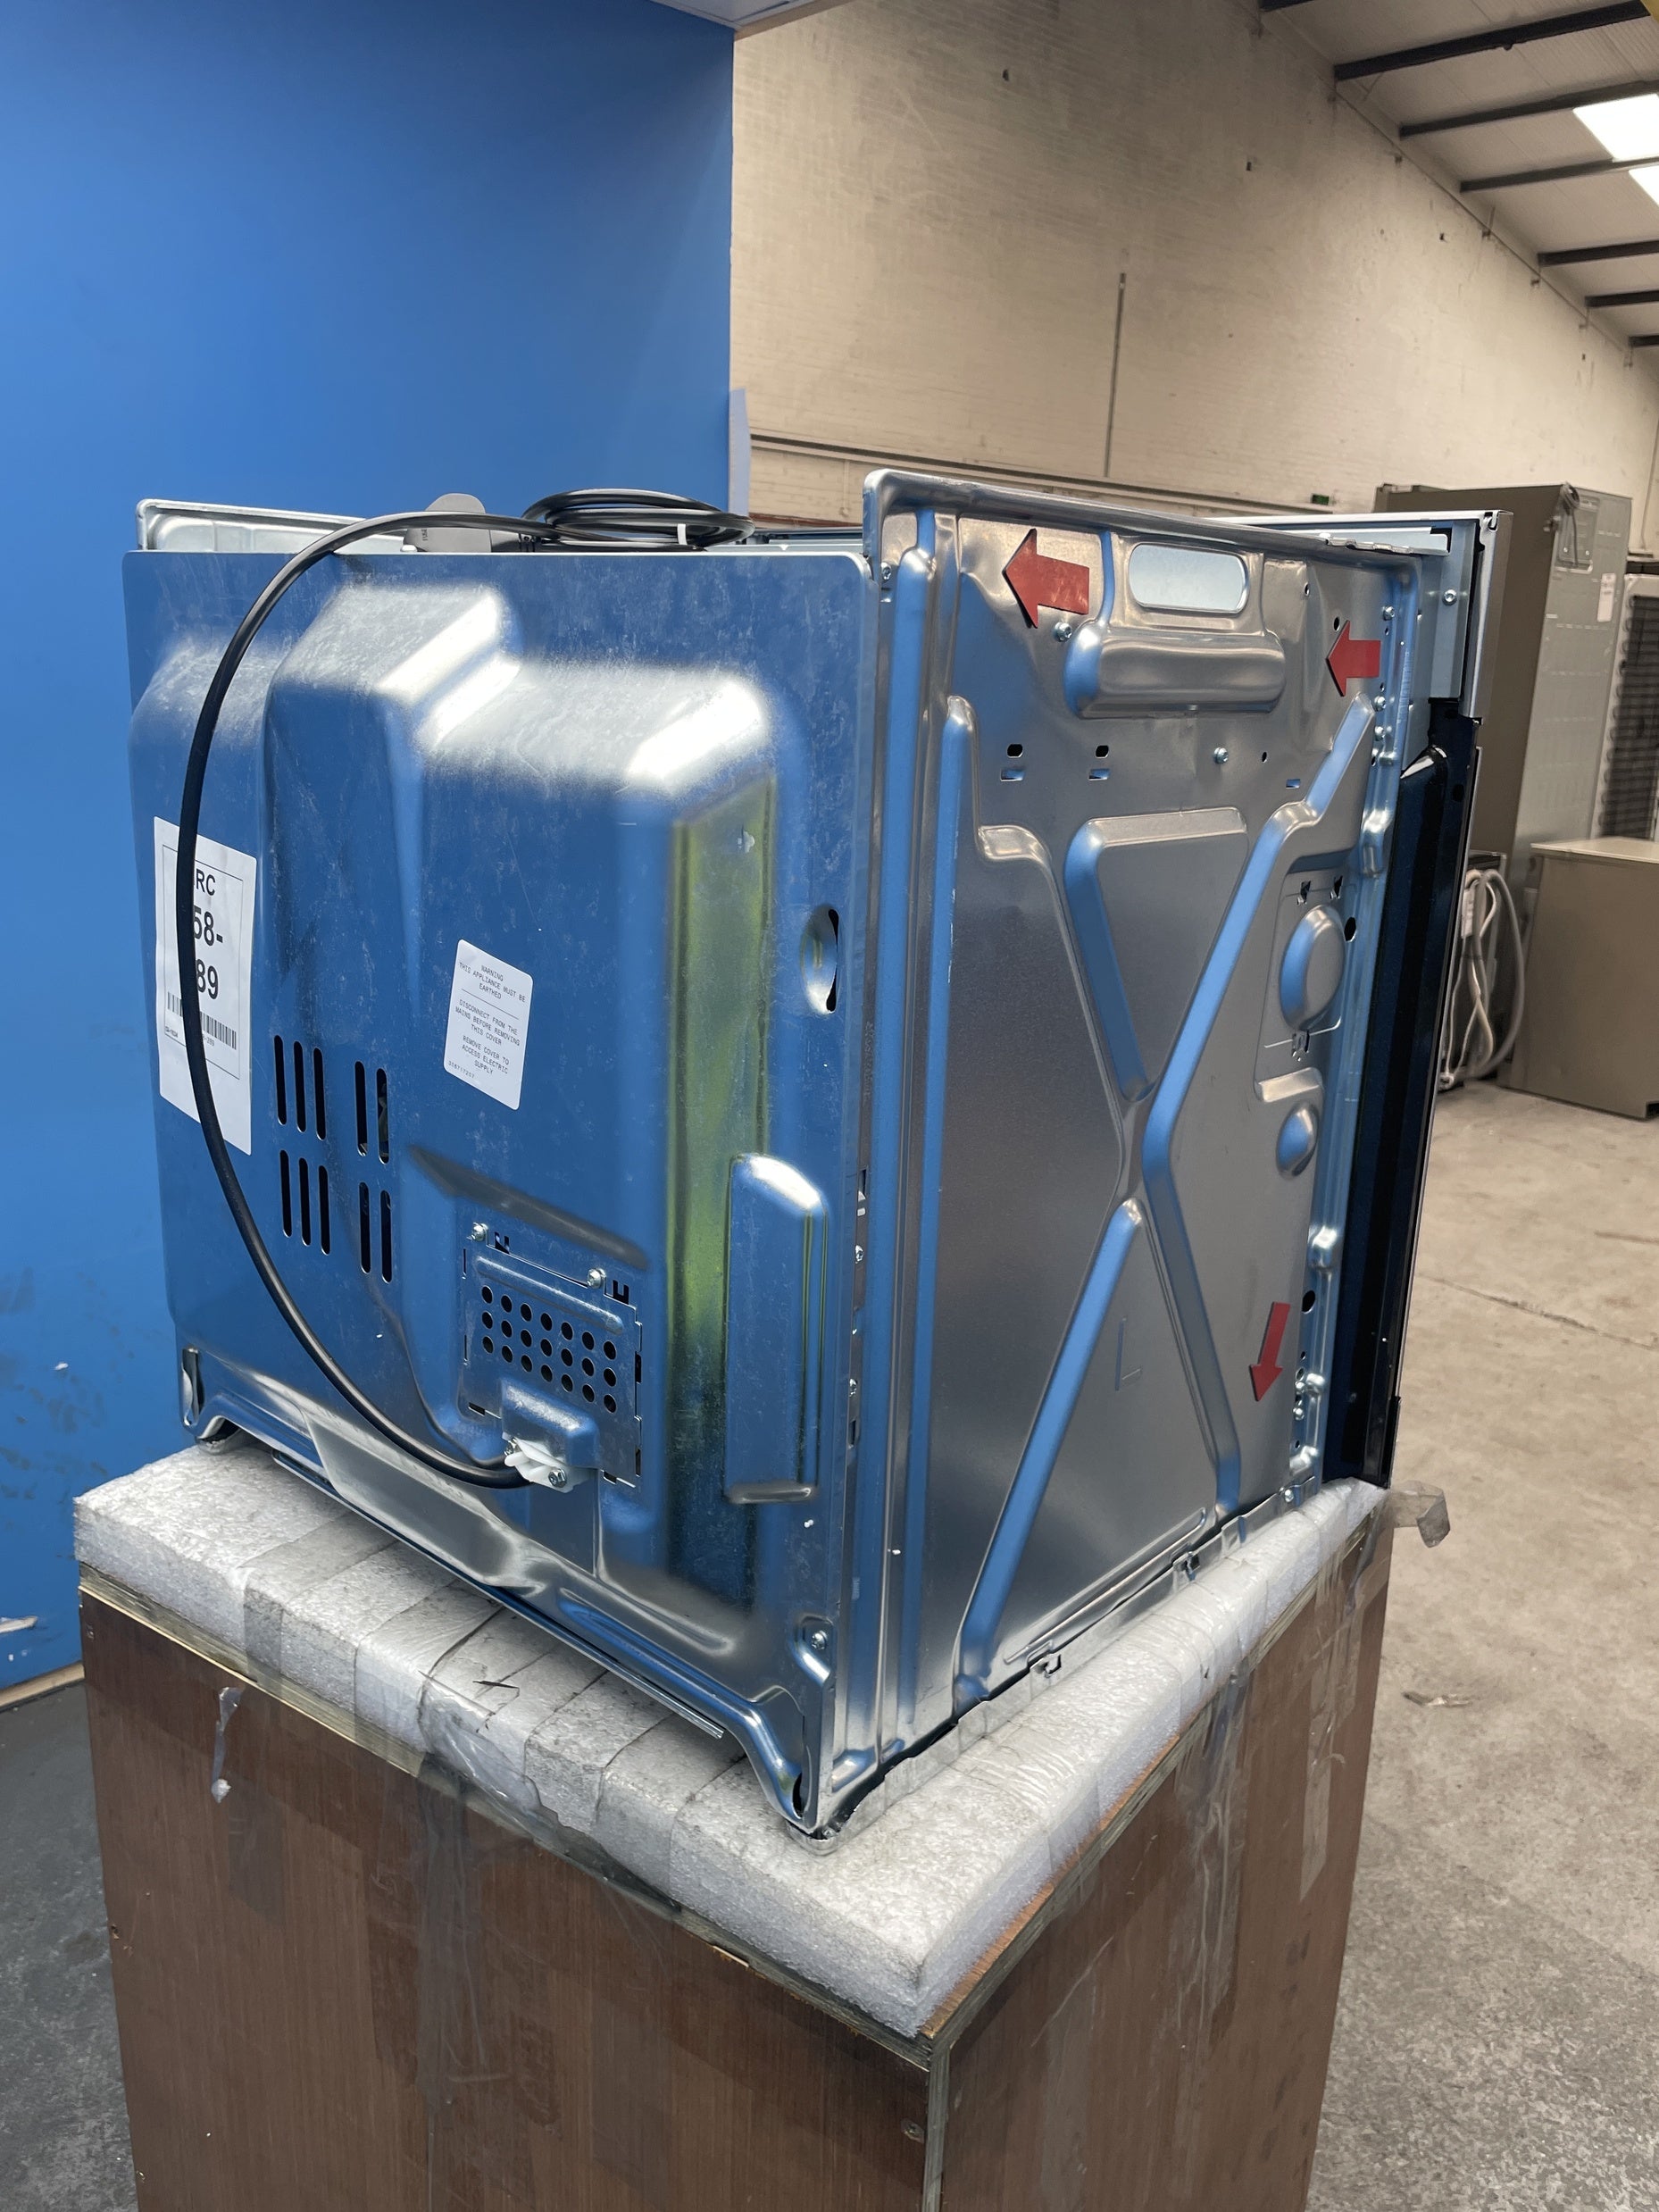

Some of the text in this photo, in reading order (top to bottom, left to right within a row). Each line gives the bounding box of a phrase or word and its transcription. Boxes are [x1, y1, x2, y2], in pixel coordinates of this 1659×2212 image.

[195, 868, 215, 896] RC
[193, 905, 223, 947] 58-
[195, 958, 219, 999] 89
[459, 962, 526, 1003] THIS APPLIANCE MUST BE
[481, 965, 504, 981] WARNING
[479, 982, 502, 999] EARTHED
[455, 1006, 520, 1047] MAINS BEFORE REMOVING
[459, 999, 518, 1036] DISCONNECT FROM THE
[471, 1023, 502, 1046] THIS COVER
[462, 1044, 508, 1074] ACCESS ELECTRIC
[463, 1035, 510, 1065] REMOVE COVER TO
[474, 1059, 494, 1074] SUPPLY
